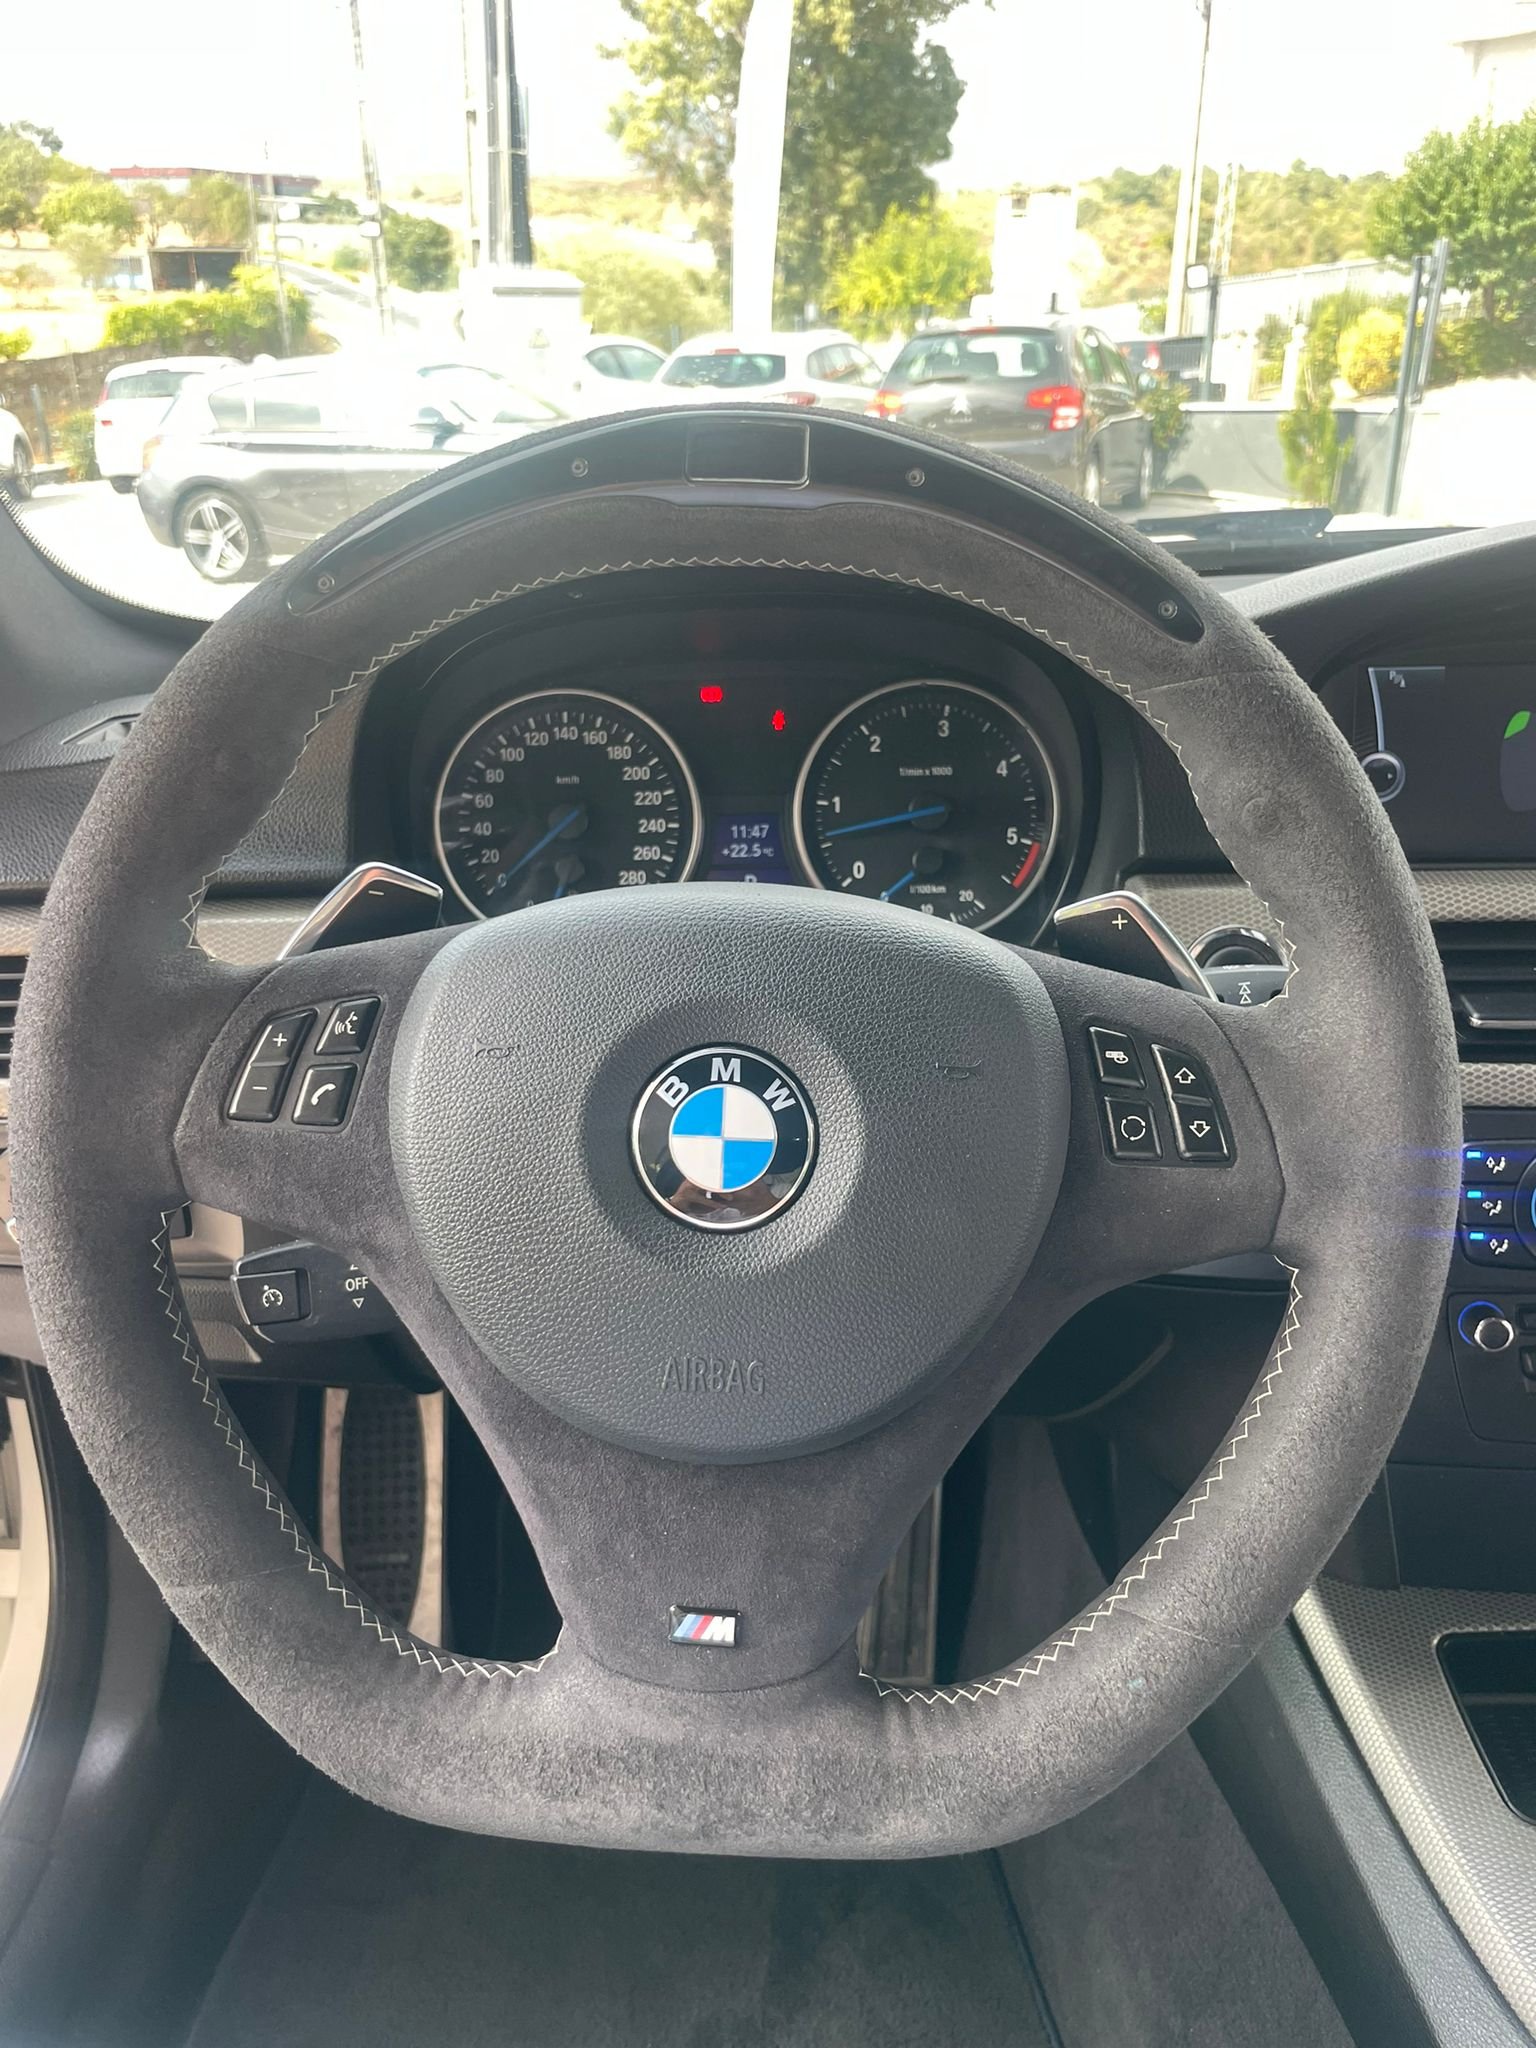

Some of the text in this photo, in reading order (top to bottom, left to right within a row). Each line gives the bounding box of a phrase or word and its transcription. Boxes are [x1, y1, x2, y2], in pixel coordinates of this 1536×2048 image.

[553, 726, 578, 741] 140
[937, 720, 950, 737] 3
[523, 732, 549, 746] 120
[582, 731, 608, 745] 160
[869, 735, 881, 752] 2
[500, 747, 525, 762] 100
[606, 746, 632, 760] 180
[485, 768, 504, 783] 80
[622, 766, 650, 781] 200
[931, 766, 953, 776] 1000
[996, 760, 1008, 777] 4
[556, 775, 580, 784] km/h
[475, 794, 494, 809] 60
[634, 791, 662, 806] 220
[831, 796, 841, 813] 1
[473, 822, 492, 836] 40
[638, 818, 666, 833] 240
[731, 825, 769, 839] 11:47
[1006, 827, 1018, 845] 5
[481, 849, 500, 864] 20
[633, 846, 661, 861] 260
[618, 870, 647, 885] 280
[852, 861, 865, 879] 0
[958, 889, 974, 902] 20
[920, 903, 934, 915] 10
[656, 1057, 796, 1112] BMW
[345, 1276, 369, 1292] OFF
[661, 1356, 765, 1395] AIRBAG
